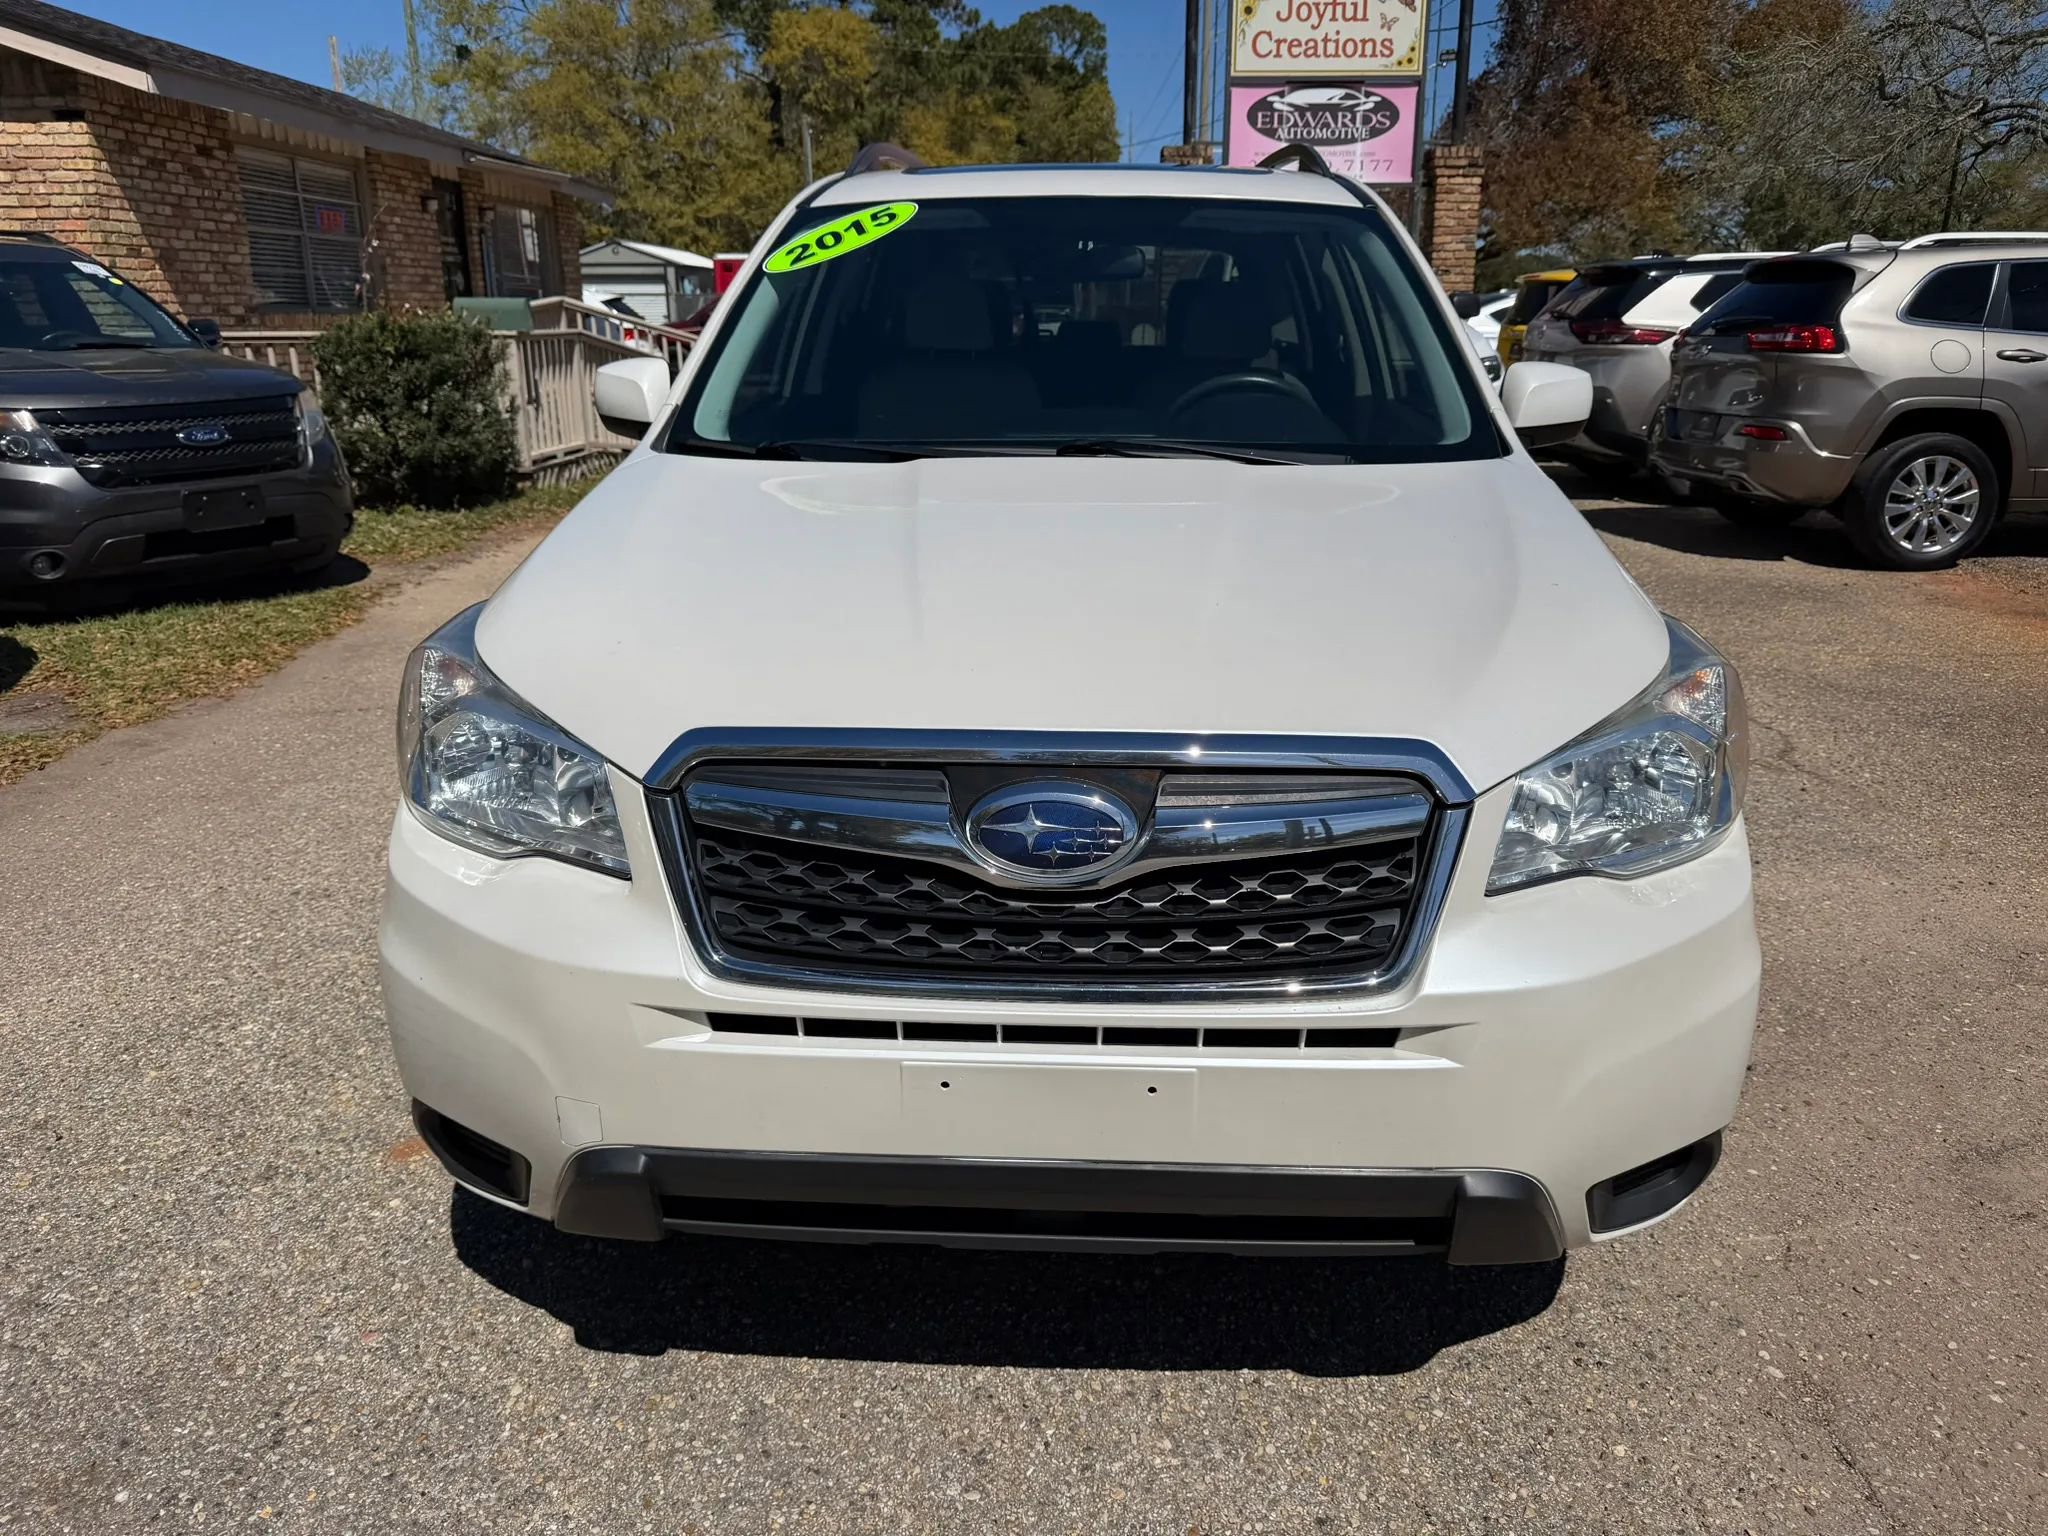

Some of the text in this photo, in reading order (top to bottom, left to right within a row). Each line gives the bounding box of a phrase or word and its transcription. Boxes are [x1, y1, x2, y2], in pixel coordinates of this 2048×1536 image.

[1276, 0, 1369, 30] Joyful
[1251, 30, 1394, 58] Creations
[1256, 111, 1391, 129] EDWARDS
[1275, 127, 1370, 140] AUTOMOTIVE
[785, 206, 897, 267] 2015
